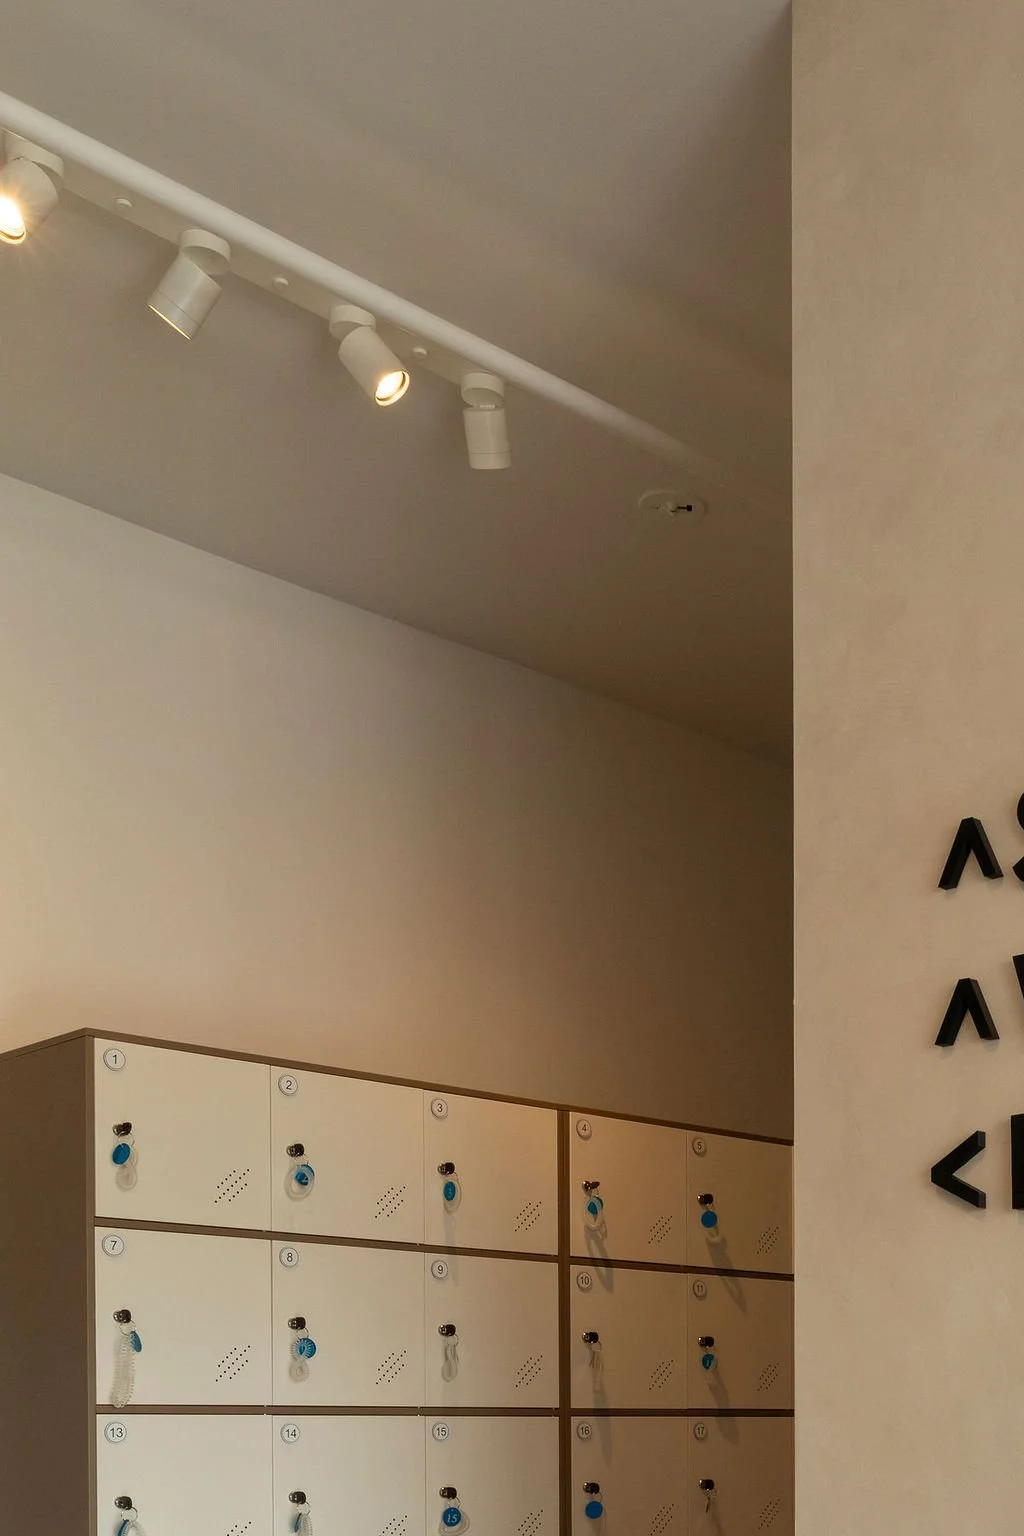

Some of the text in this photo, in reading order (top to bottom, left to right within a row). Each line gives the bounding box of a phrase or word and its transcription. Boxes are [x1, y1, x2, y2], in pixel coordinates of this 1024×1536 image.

[285, 1079, 293, 1091] 2
[436, 1102, 444, 1113] 3
[581, 1123, 587, 1132] 4
[696, 1141, 703, 1151] 5
[110, 1240, 118, 1251] 7
[286, 1252, 294, 1263] 8
[437, 1264, 444, 1275] 9
[580, 1275, 590, 1286] 10
[696, 1284, 704, 1293] 11
[109, 1427, 124, 1438] 13
[285, 1428, 297, 1438] 14
[436, 1426, 447, 1437] 15
[580, 1425, 590, 1436] 16
[697, 1426, 705, 1435] 17
[447, 1513, 458, 1523] 15
